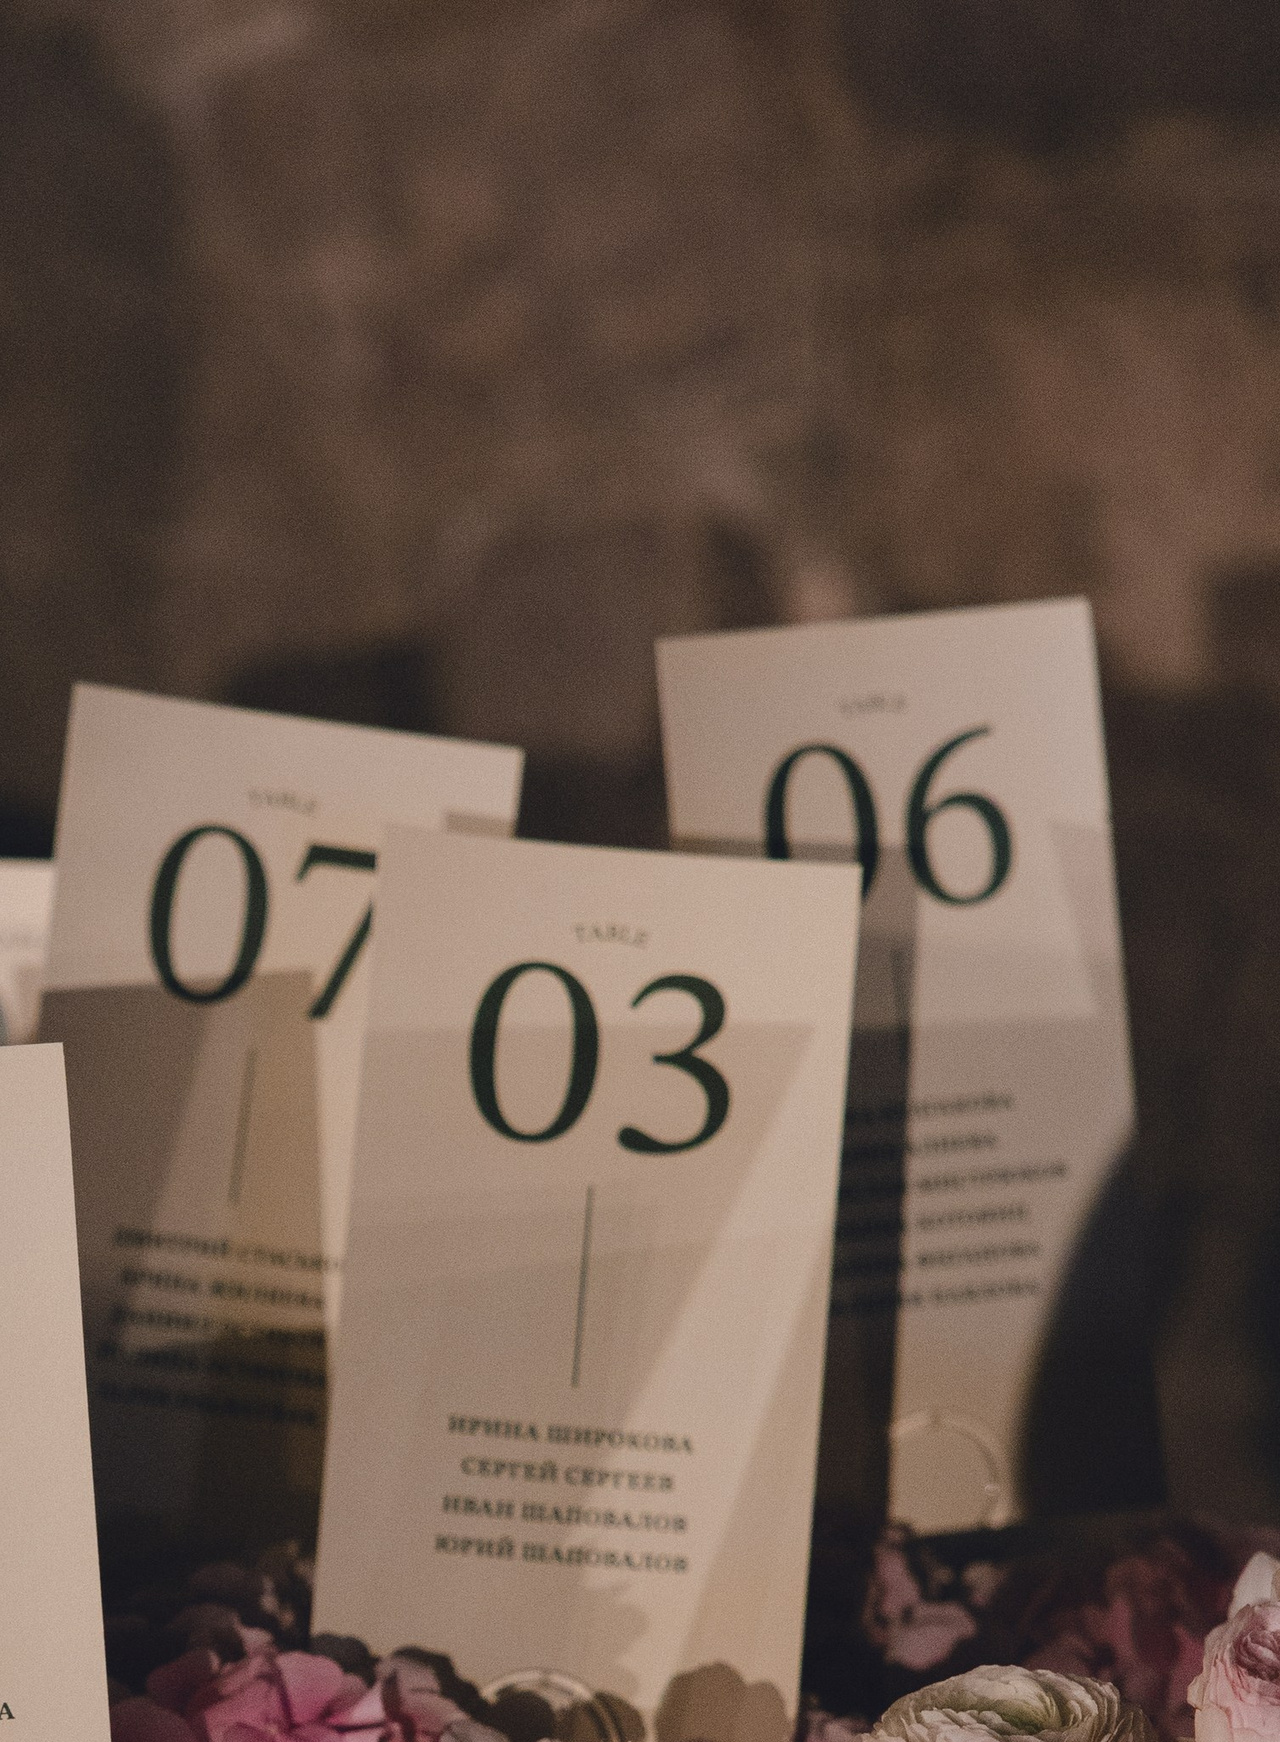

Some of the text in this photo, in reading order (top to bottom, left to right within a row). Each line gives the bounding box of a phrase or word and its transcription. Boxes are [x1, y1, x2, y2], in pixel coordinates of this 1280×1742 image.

[764, 724, 1014, 906] 06
[149, 824, 376, 1022] 07
[574, 921, 648, 949] TABLE
[469, 961, 731, 1155] 03
[547, 1424, 692, 1453] ШИРОКОВА
[460, 1456, 673, 1490] СЕРГЕЙ СЕРГЕЕВ
[442, 1496, 514, 1520] ИВАН
